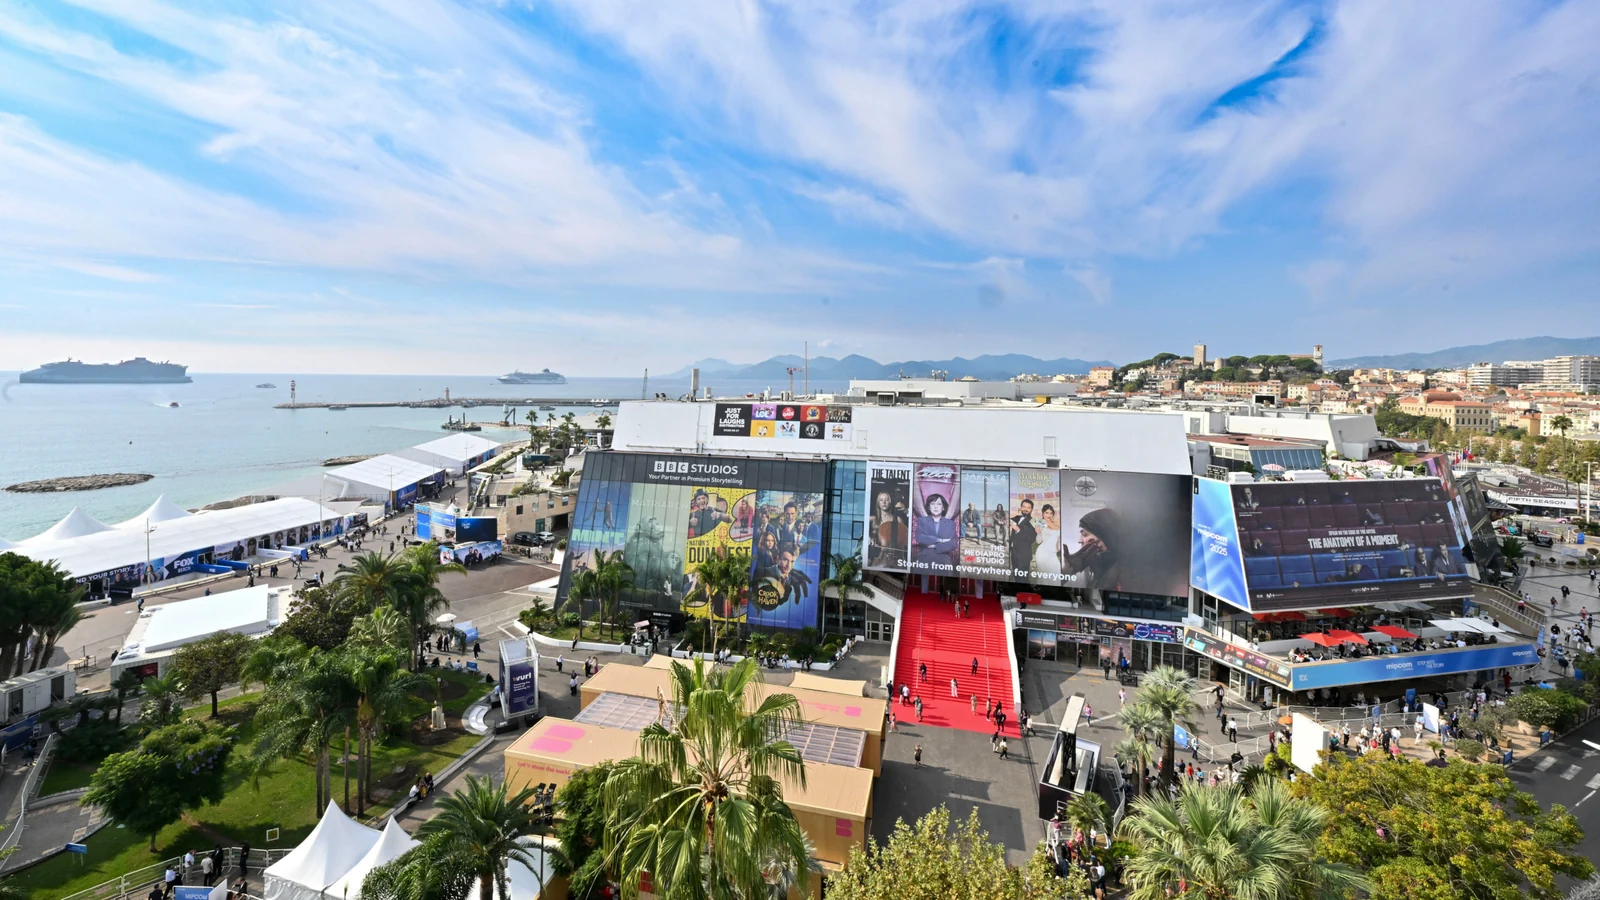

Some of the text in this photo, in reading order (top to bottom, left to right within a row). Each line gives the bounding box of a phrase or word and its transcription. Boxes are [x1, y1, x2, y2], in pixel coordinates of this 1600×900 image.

[654, 461, 738, 474] BBC STUDIOS
[872, 469, 884, 479] THE
[885, 469, 910, 480] TALENT
[1197, 528, 1228, 542] mipcom
[1308, 534, 1399, 549] THE ANATOMY OF A MOMENT
[689, 546, 750, 563] DUMEST
[964, 549, 1005, 558] MEDIAPRO
[1210, 543, 1228, 556] 2025
[174, 557, 194, 569] FOX
[976, 556, 1005, 565] STUDIO
[89, 572, 107, 580] YOUR
[897, 559, 1077, 581] Stories from everywhere for everyone
[513, 672, 531, 681] wurl
